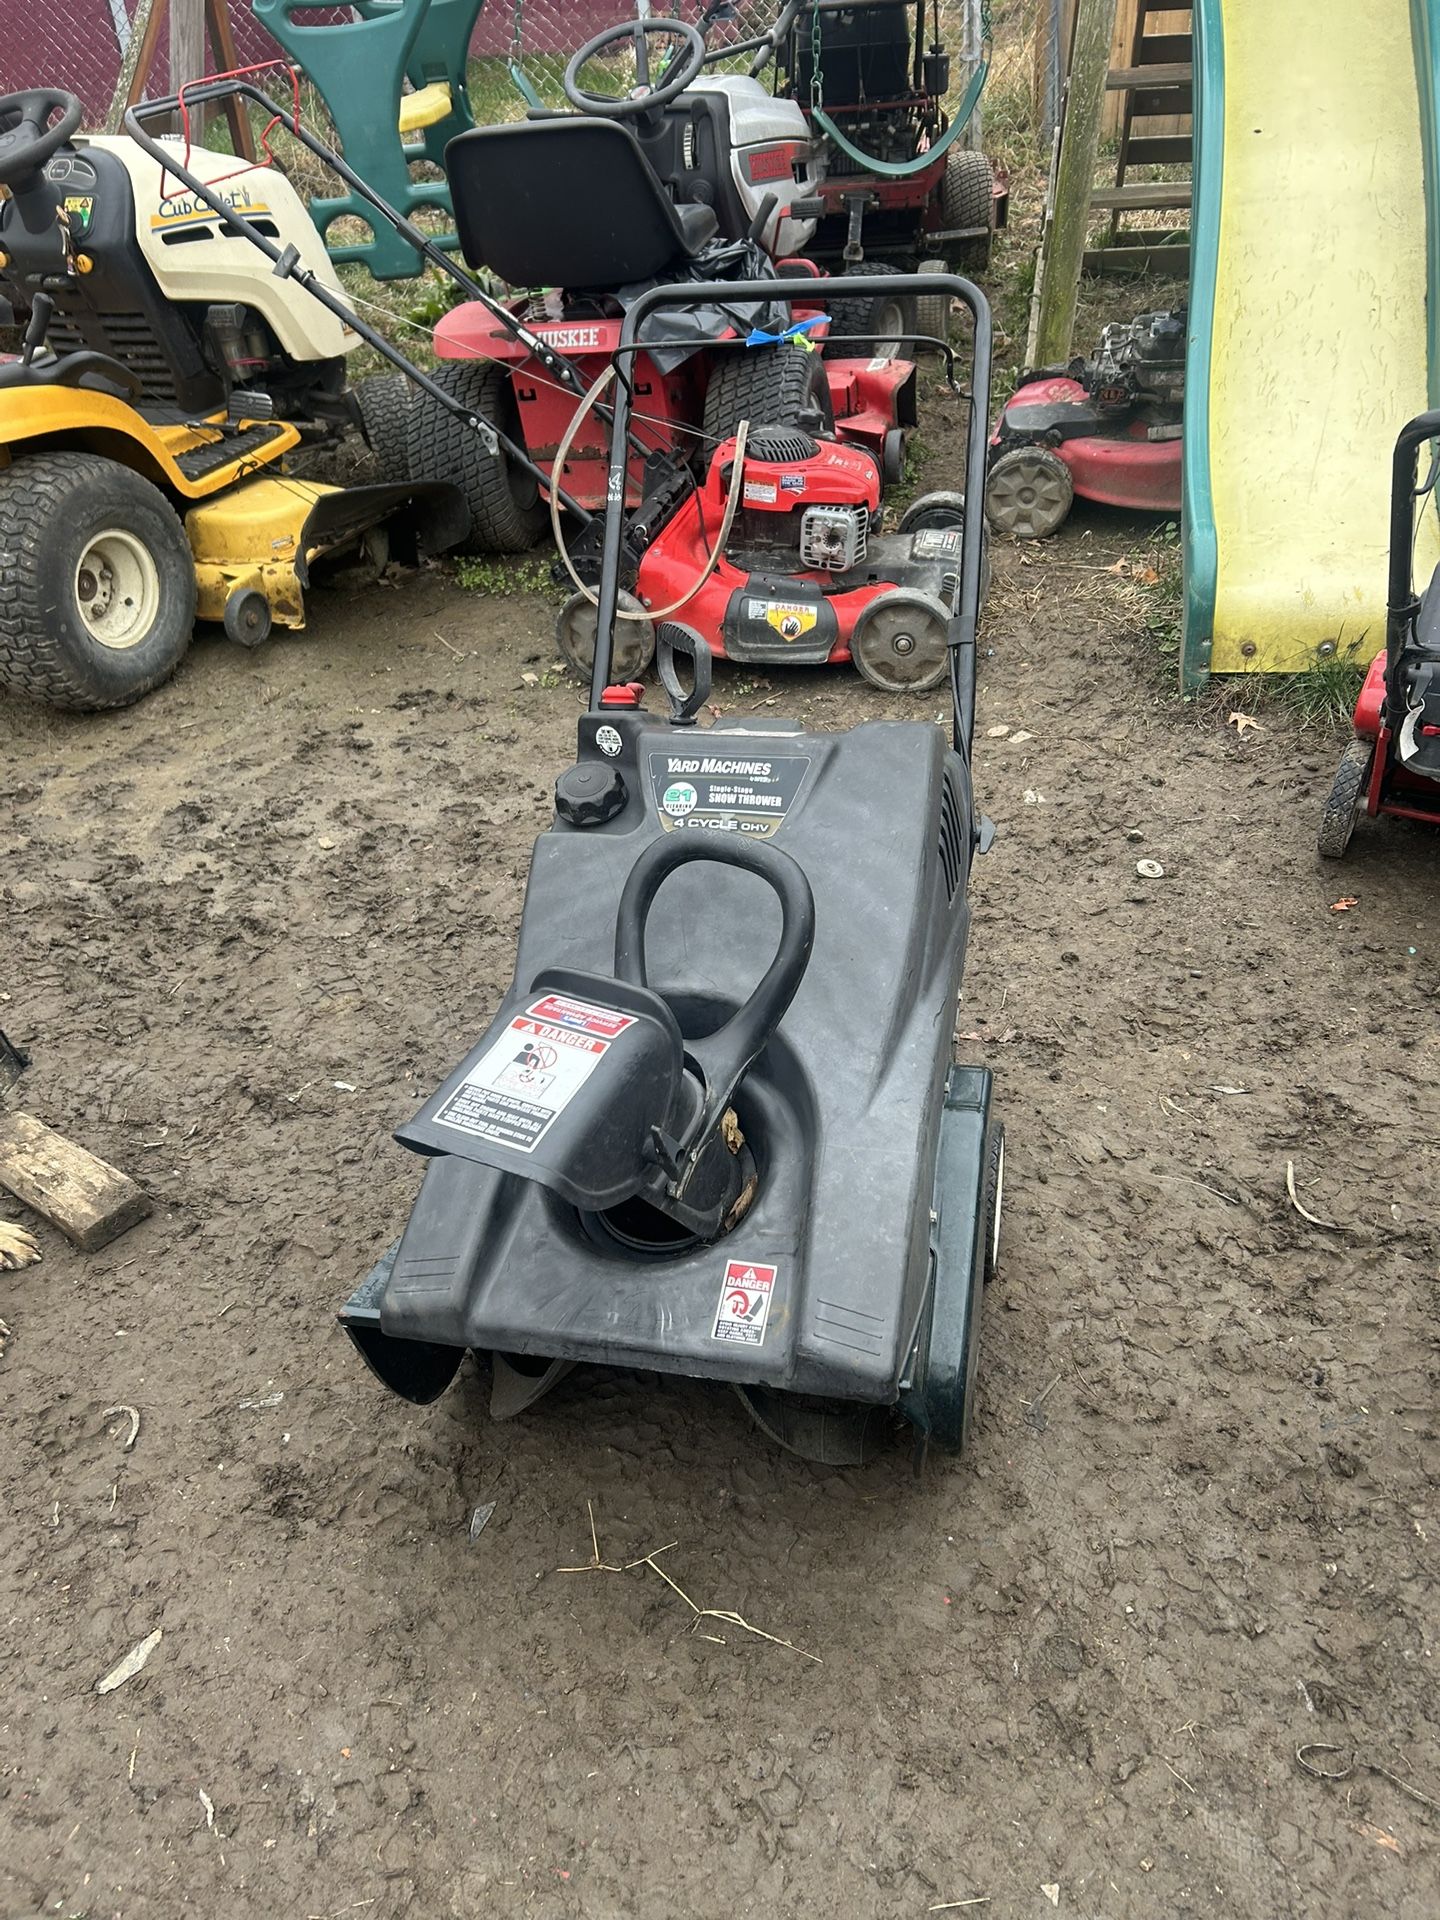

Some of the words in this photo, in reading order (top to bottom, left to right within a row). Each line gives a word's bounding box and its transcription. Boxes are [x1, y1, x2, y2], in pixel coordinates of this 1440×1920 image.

[159, 198, 192, 218] Cub
[194, 191, 241, 212] Cet
[667, 758, 699, 773] YARD
[700, 758, 772, 776] MACHINES
[709, 784, 753, 794] Single-Stage
[709, 792, 736, 805] SNOW
[738, 794, 782, 807] THROWER
[673, 819, 684, 828] 4
[687, 819, 738, 831] CYCLE
[741, 822, 769, 832] OHV
[539, 1026, 596, 1051] DANGER
[727, 1276, 770, 1291] DANGER
